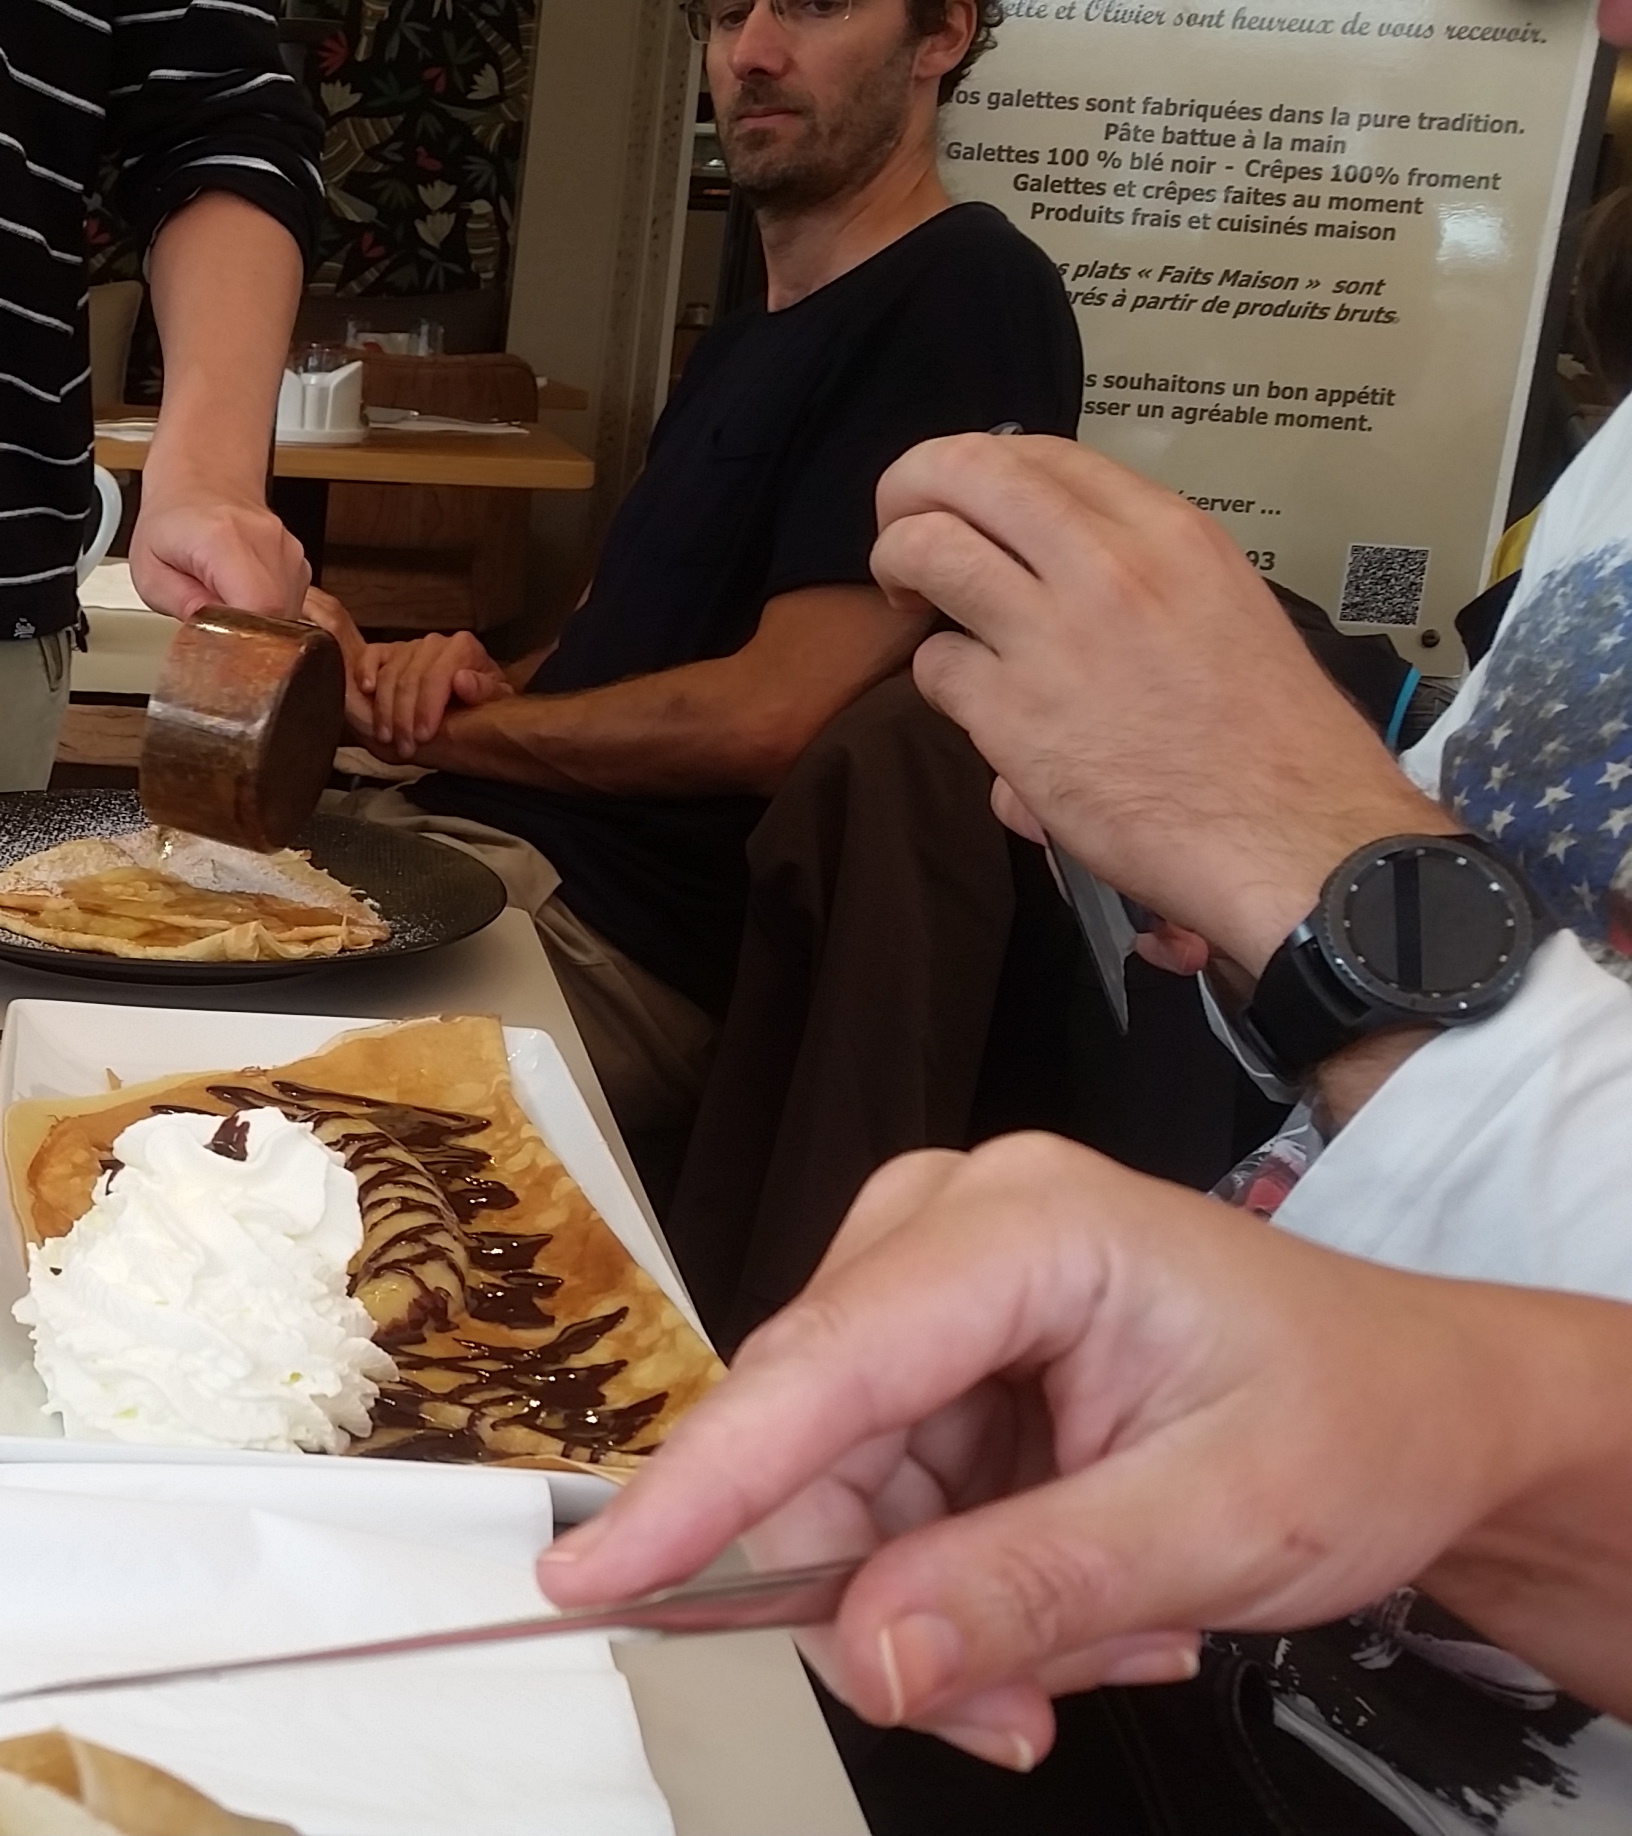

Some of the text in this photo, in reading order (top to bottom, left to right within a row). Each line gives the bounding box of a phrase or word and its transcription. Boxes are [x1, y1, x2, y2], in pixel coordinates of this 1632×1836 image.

[1172, 12, 1225, 29] sont
[1231, 7, 1336, 34] heureux
[1341, 12, 1369, 36] de
[1377, 20, 1436, 40] vous
[1445, 22, 1548, 44] recevoir.
[950, 88, 1525, 134] os galettes sont fabriquées dans la pure tradition.
[1104, 122, 1346, 154] Pâte battue à la main
[946, 142, 1040, 163] Galettes
[1047, 148, 1089, 167] 100
[1097, 151, 1122, 169] %
[1129, 152, 1164, 172] blé
[1170, 157, 1216, 175] noir
[1245, 159, 1323, 183] Crêpes
[1330, 163, 1400, 185] 100%
[1407, 168, 1502, 190] froment
[1013, 173, 1424, 214] Galettes et crêpes faites au moment
[1030, 202, 1396, 241] Produits frais et cuisinés maison
[1071, 260, 1131, 281] plats
[1157, 265, 1214, 286] Faits
[1218, 269, 1299, 291] Maison
[1332, 278, 1386, 296] sont
[1111, 288, 1127, 307] à
[1129, 293, 1197, 313] partir
[1201, 296, 1230, 314] de
[1232, 300, 1330, 320] produits
[1103, 373, 1225, 395] souhaitons
[1233, 381, 1260, 398] un
[1267, 380, 1308, 400] bon
[1315, 385, 1396, 408] appétit
[1137, 404, 1164, 418] un
[1171, 405, 1268, 426] agréable
[1274, 413, 1373, 432] moment.
